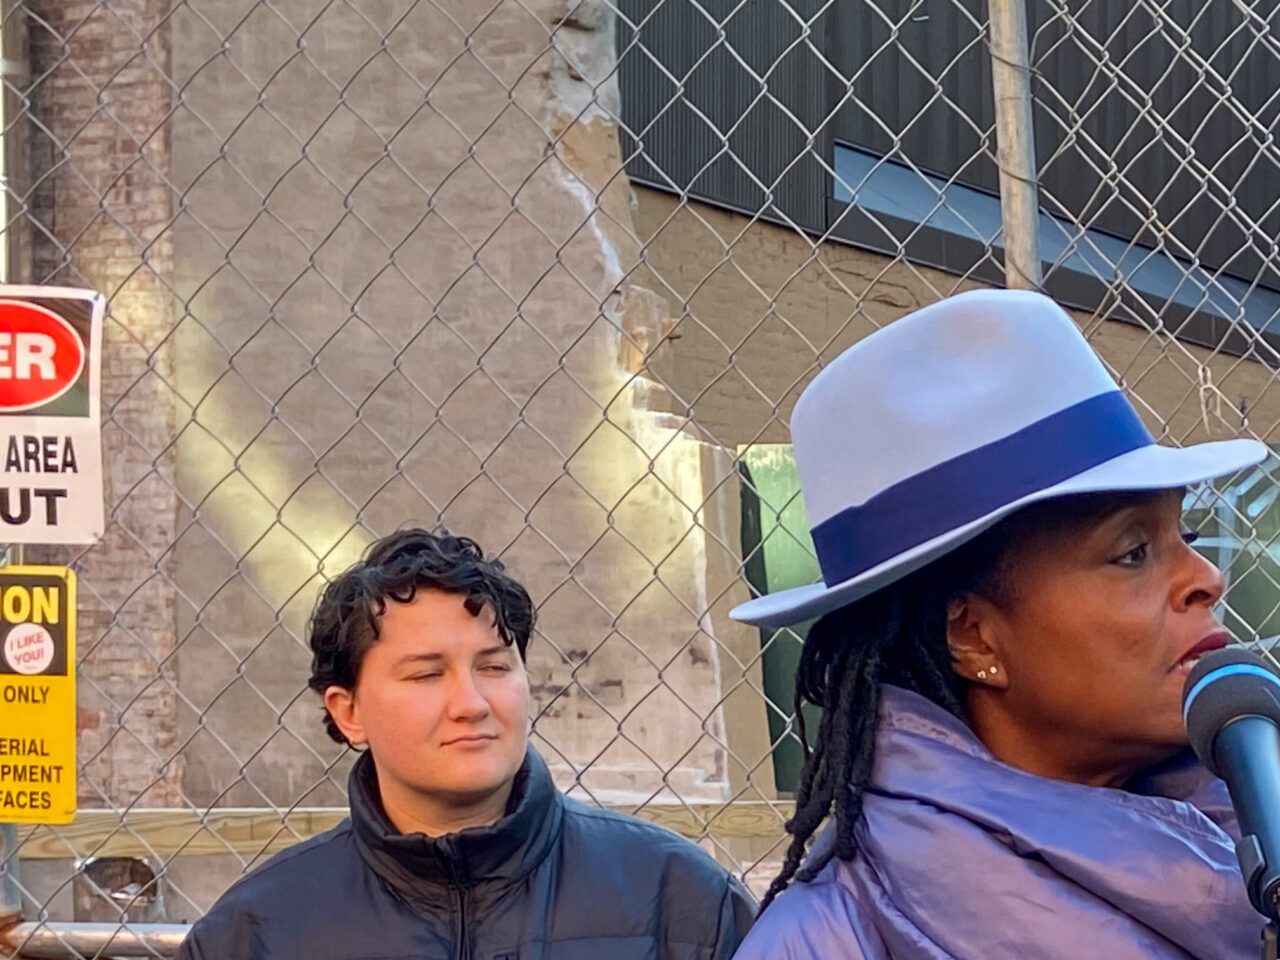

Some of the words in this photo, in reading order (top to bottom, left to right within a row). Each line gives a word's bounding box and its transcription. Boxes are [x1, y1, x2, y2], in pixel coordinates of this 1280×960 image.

[4, 435, 78, 474] AREA
[0, 585, 59, 625] ON
[17, 632, 45, 649] LIKE
[14, 648, 45, 665] YOU!
[3, 685, 50, 704] ONLY
[1, 764, 63, 784] PMENT
